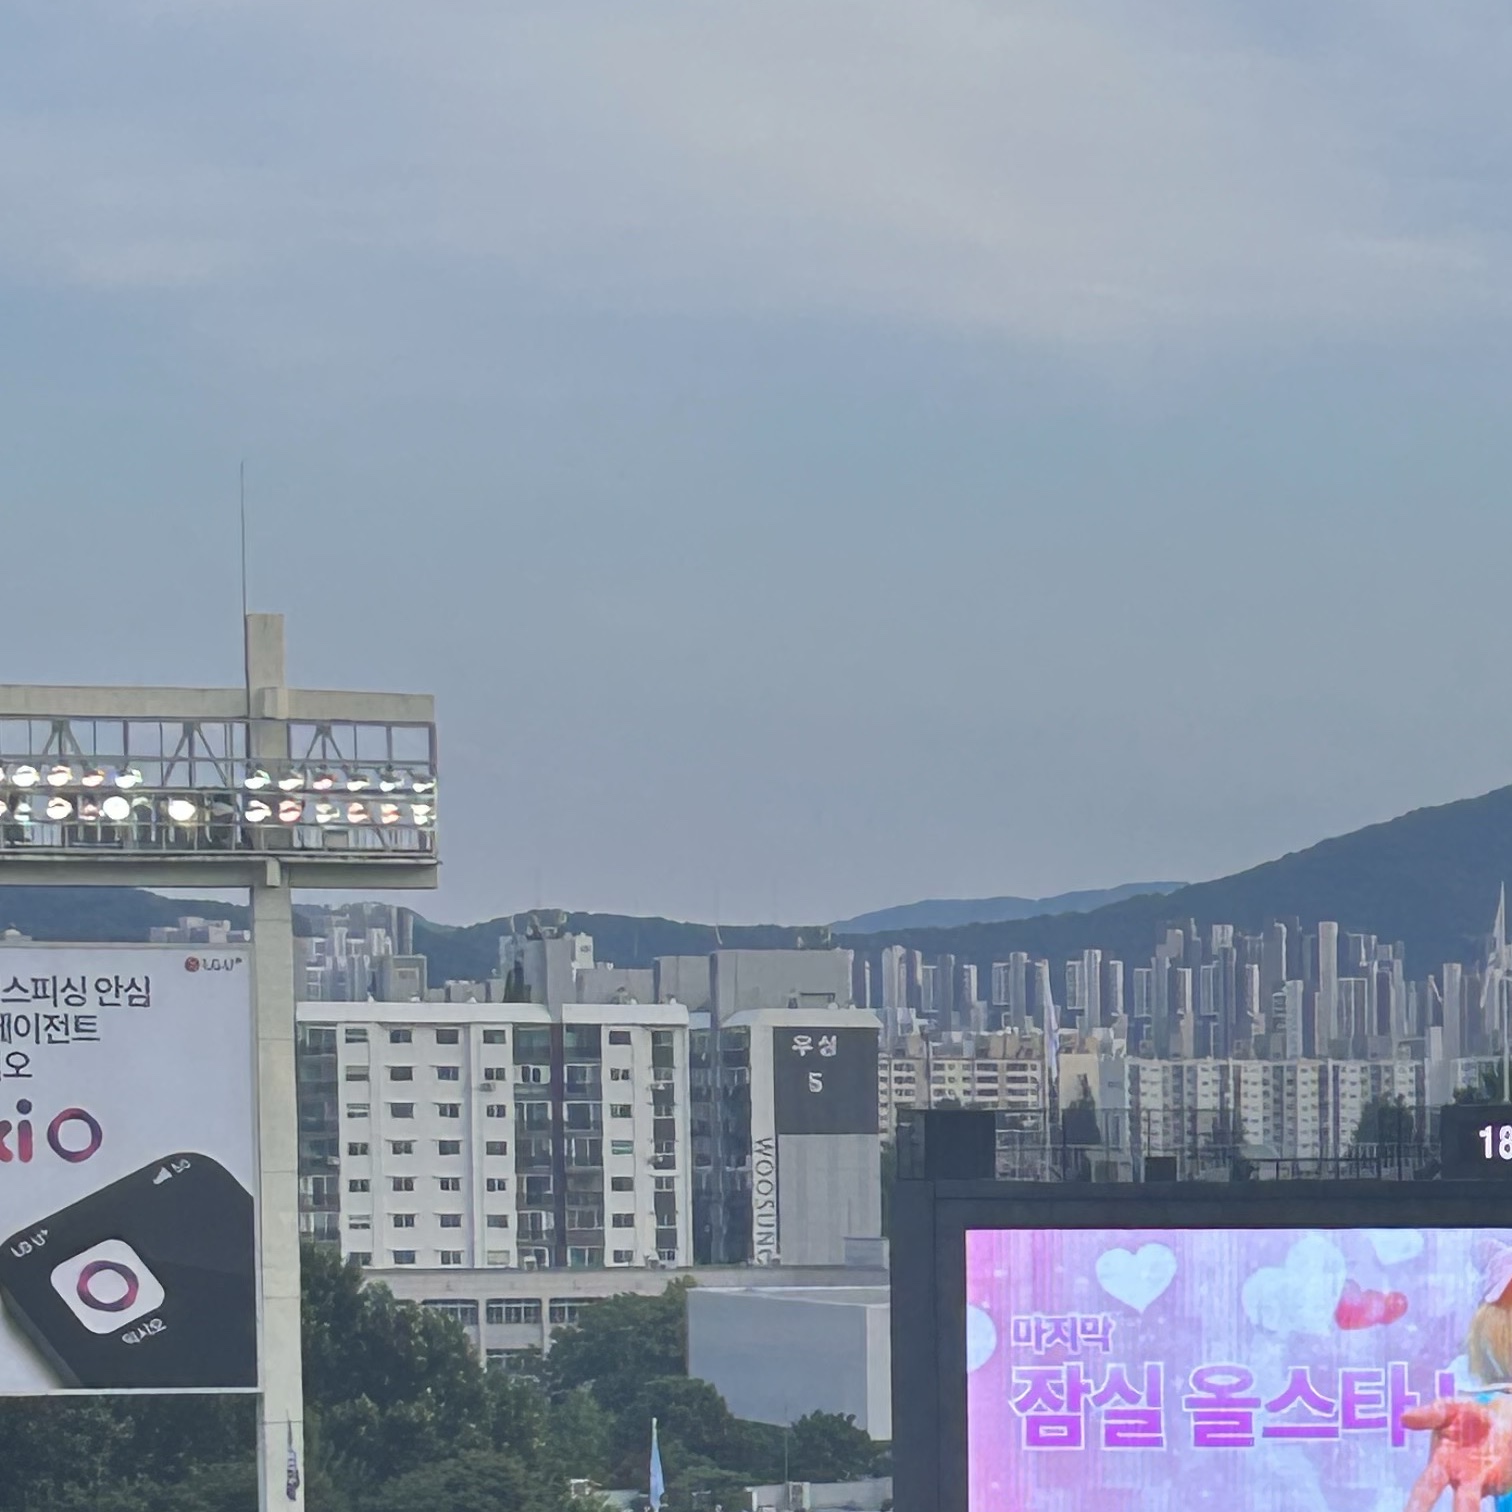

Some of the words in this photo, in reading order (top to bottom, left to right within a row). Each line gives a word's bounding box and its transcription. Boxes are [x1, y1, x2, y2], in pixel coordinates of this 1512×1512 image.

[0, 975, 87, 1007] 스피싱
[94, 975, 151, 1008] 안심
[808, 1071, 823, 1093] 5
[1011, 1313, 1115, 1354] 마지막
[1009, 1361, 1167, 1450] 잠실
[1181, 1361, 1457, 1450] 올스타
